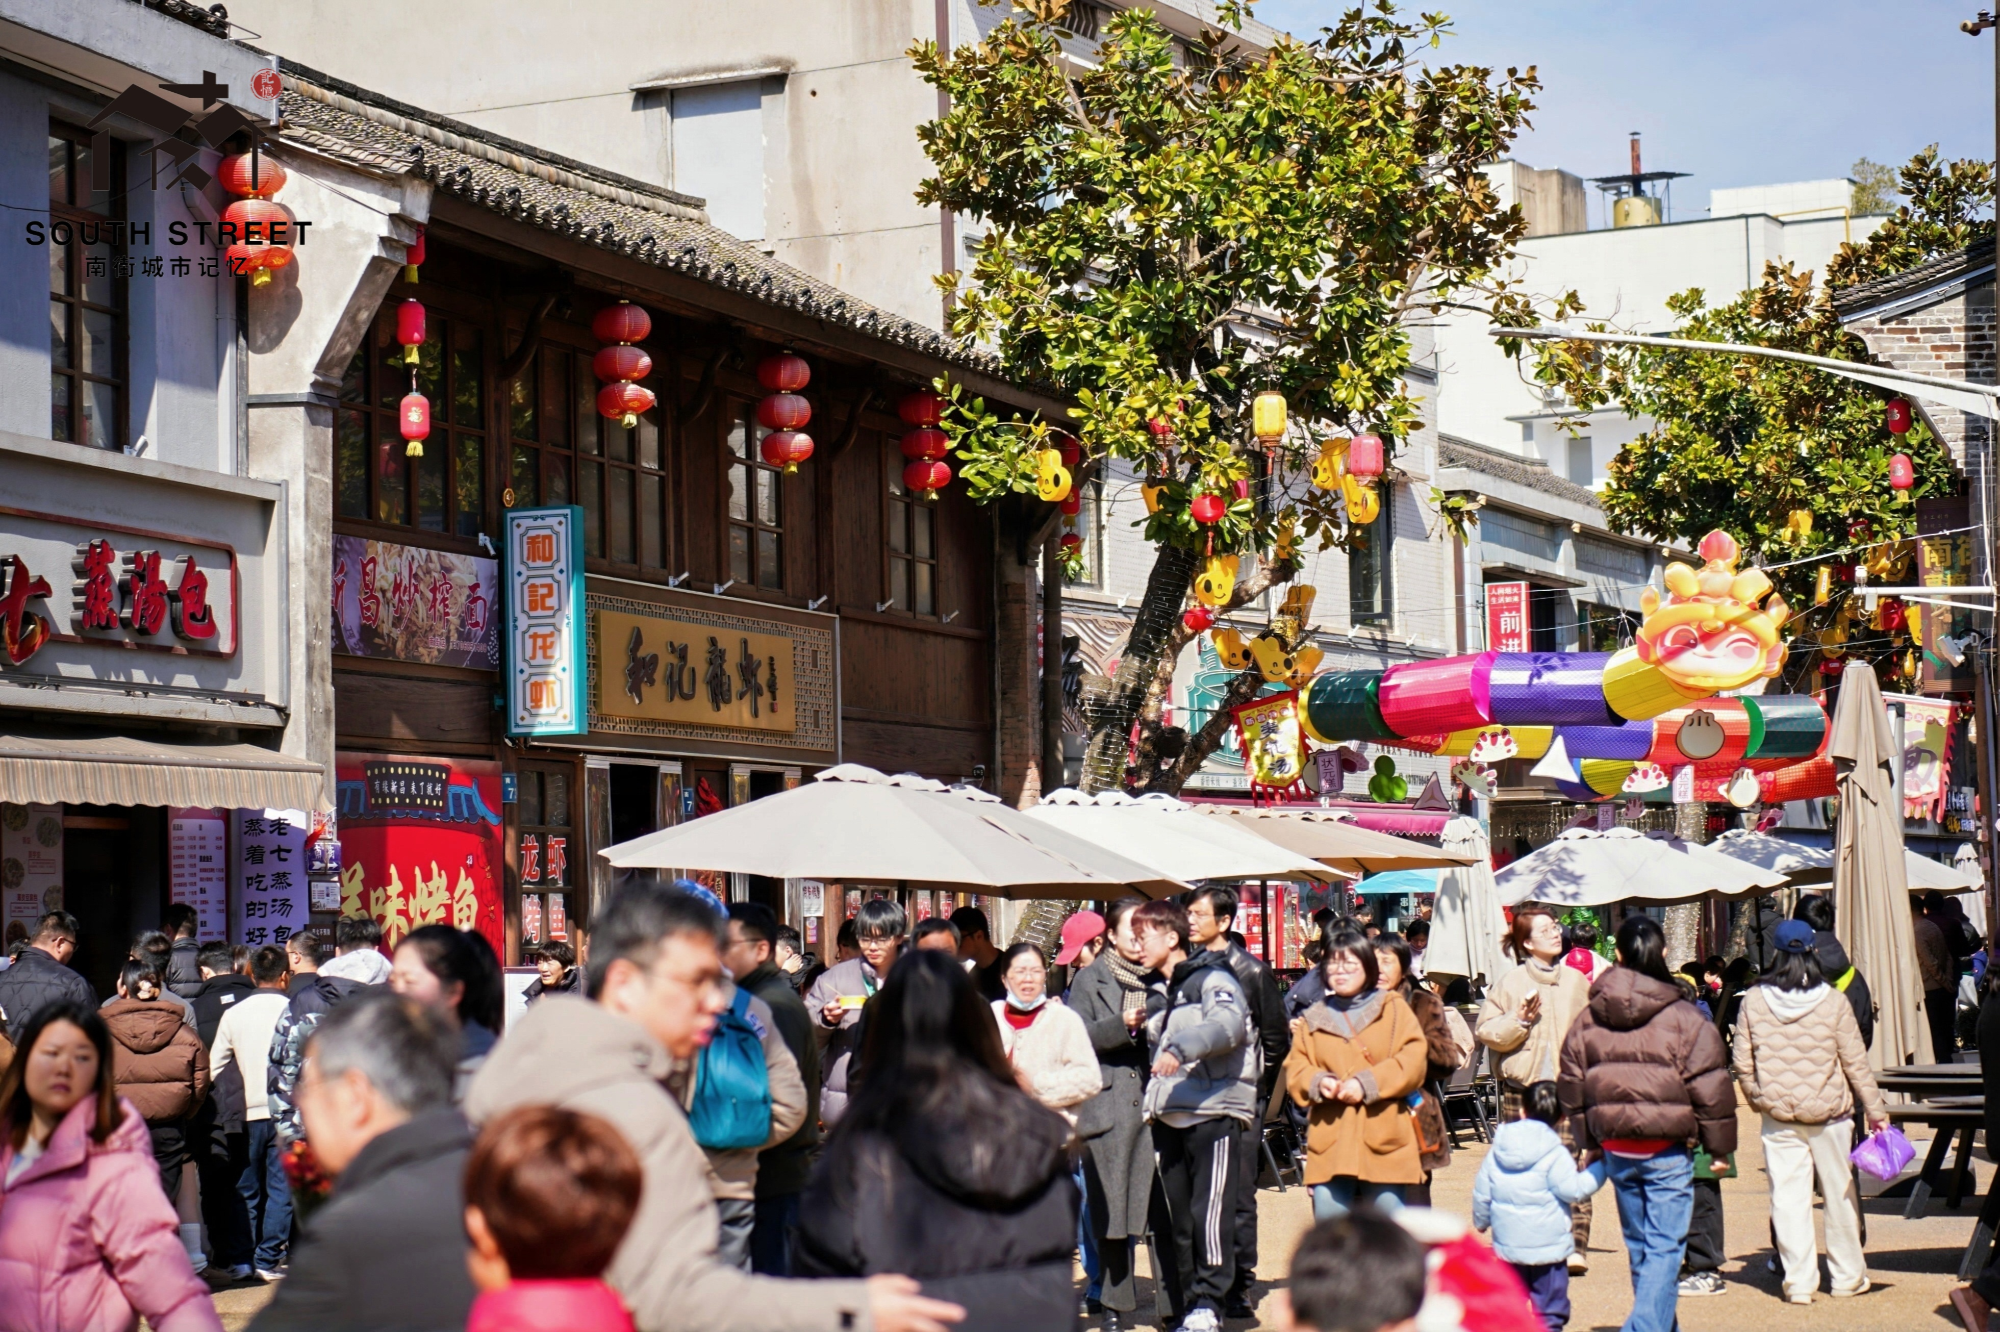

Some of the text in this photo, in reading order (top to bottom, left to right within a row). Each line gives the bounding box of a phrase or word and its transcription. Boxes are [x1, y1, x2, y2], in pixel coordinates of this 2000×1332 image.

[374, 779, 442, 796] 有缘新昌 来了就好
[1321, 758, 1336, 788] 状元糕
[1678, 771, 1690, 799] 状元糕
[243, 818, 268, 946] 蒸着吃的好
[269, 817, 293, 944] 老七蒸汤包
[521, 834, 567, 884] 龙虾
[521, 893, 568, 943] 烤鱼
